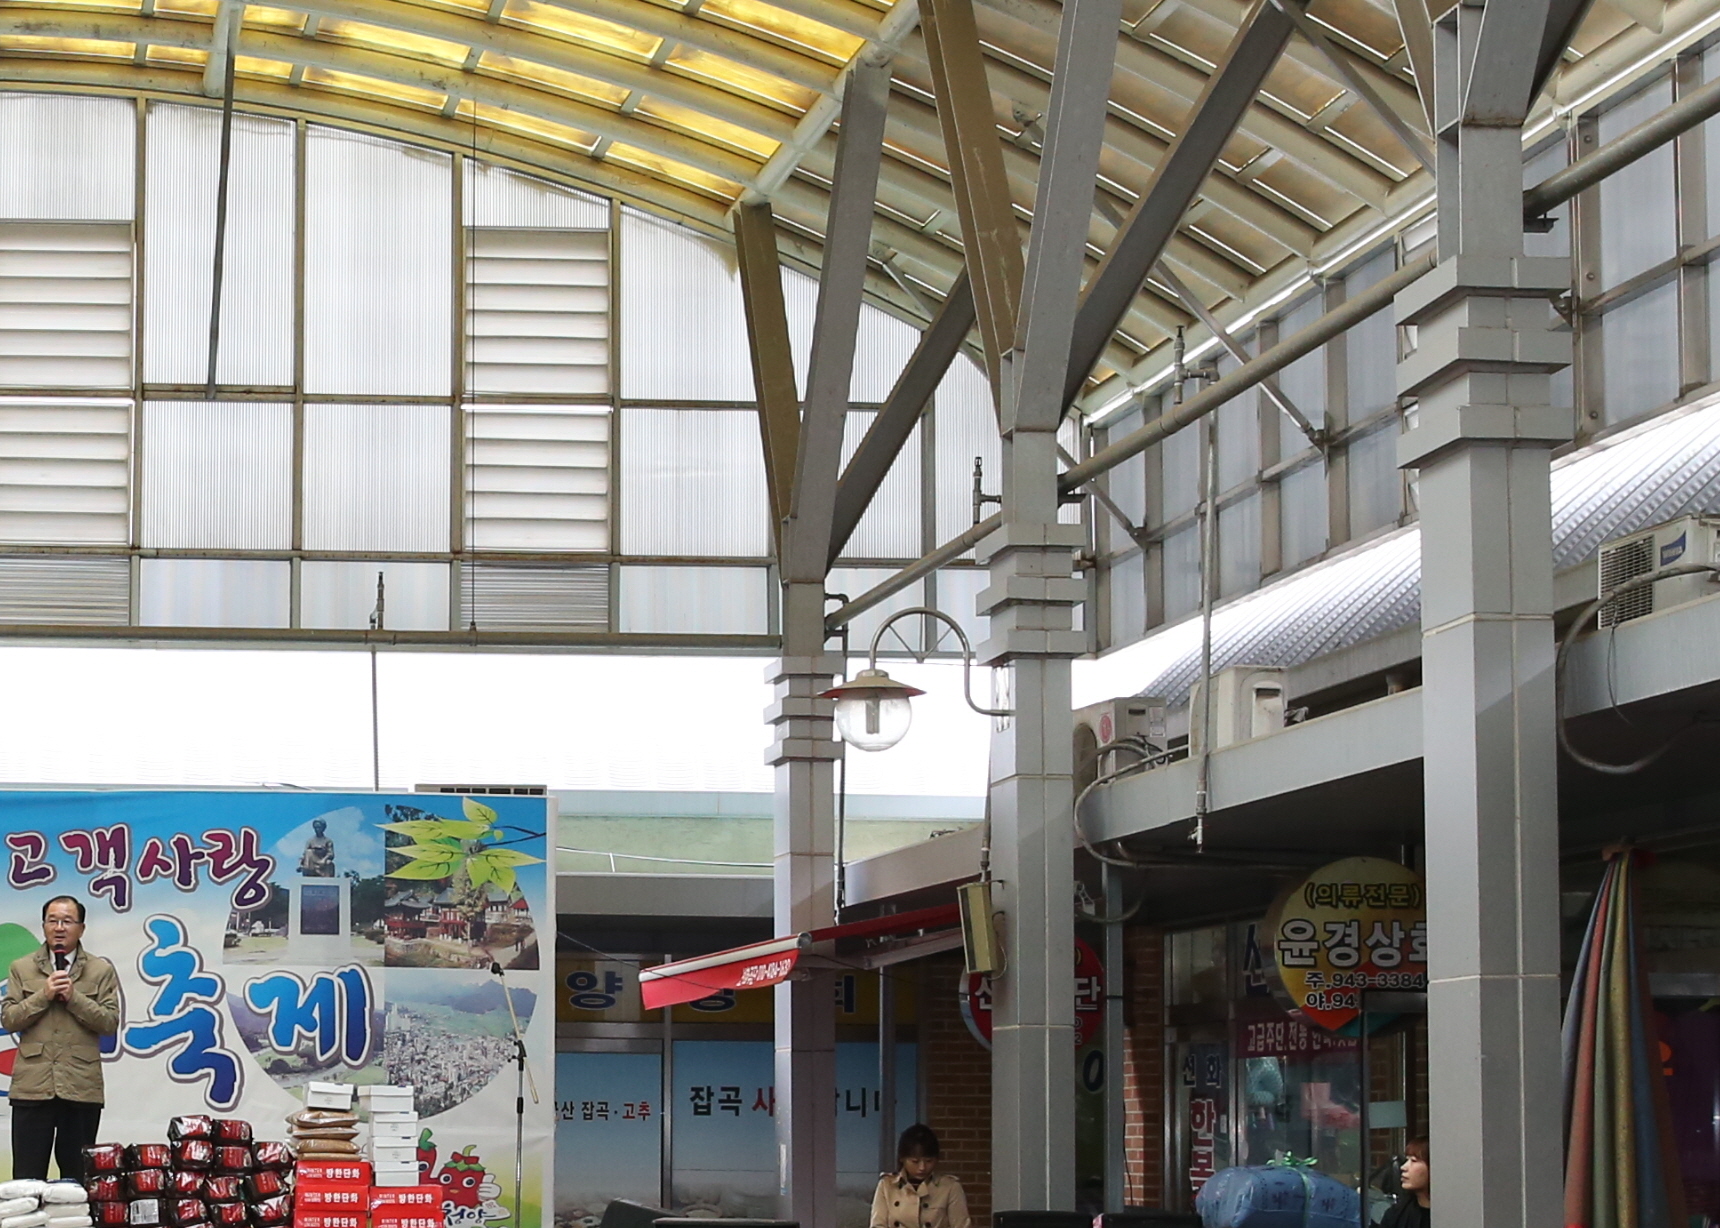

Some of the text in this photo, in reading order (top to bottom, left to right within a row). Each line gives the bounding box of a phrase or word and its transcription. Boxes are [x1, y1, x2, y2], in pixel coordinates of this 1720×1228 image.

[6, 824, 273, 909] 고객사랑
[1304, 882, 1421, 908] (의류전문)
[689, 1086, 743, 1117] 잡곡
